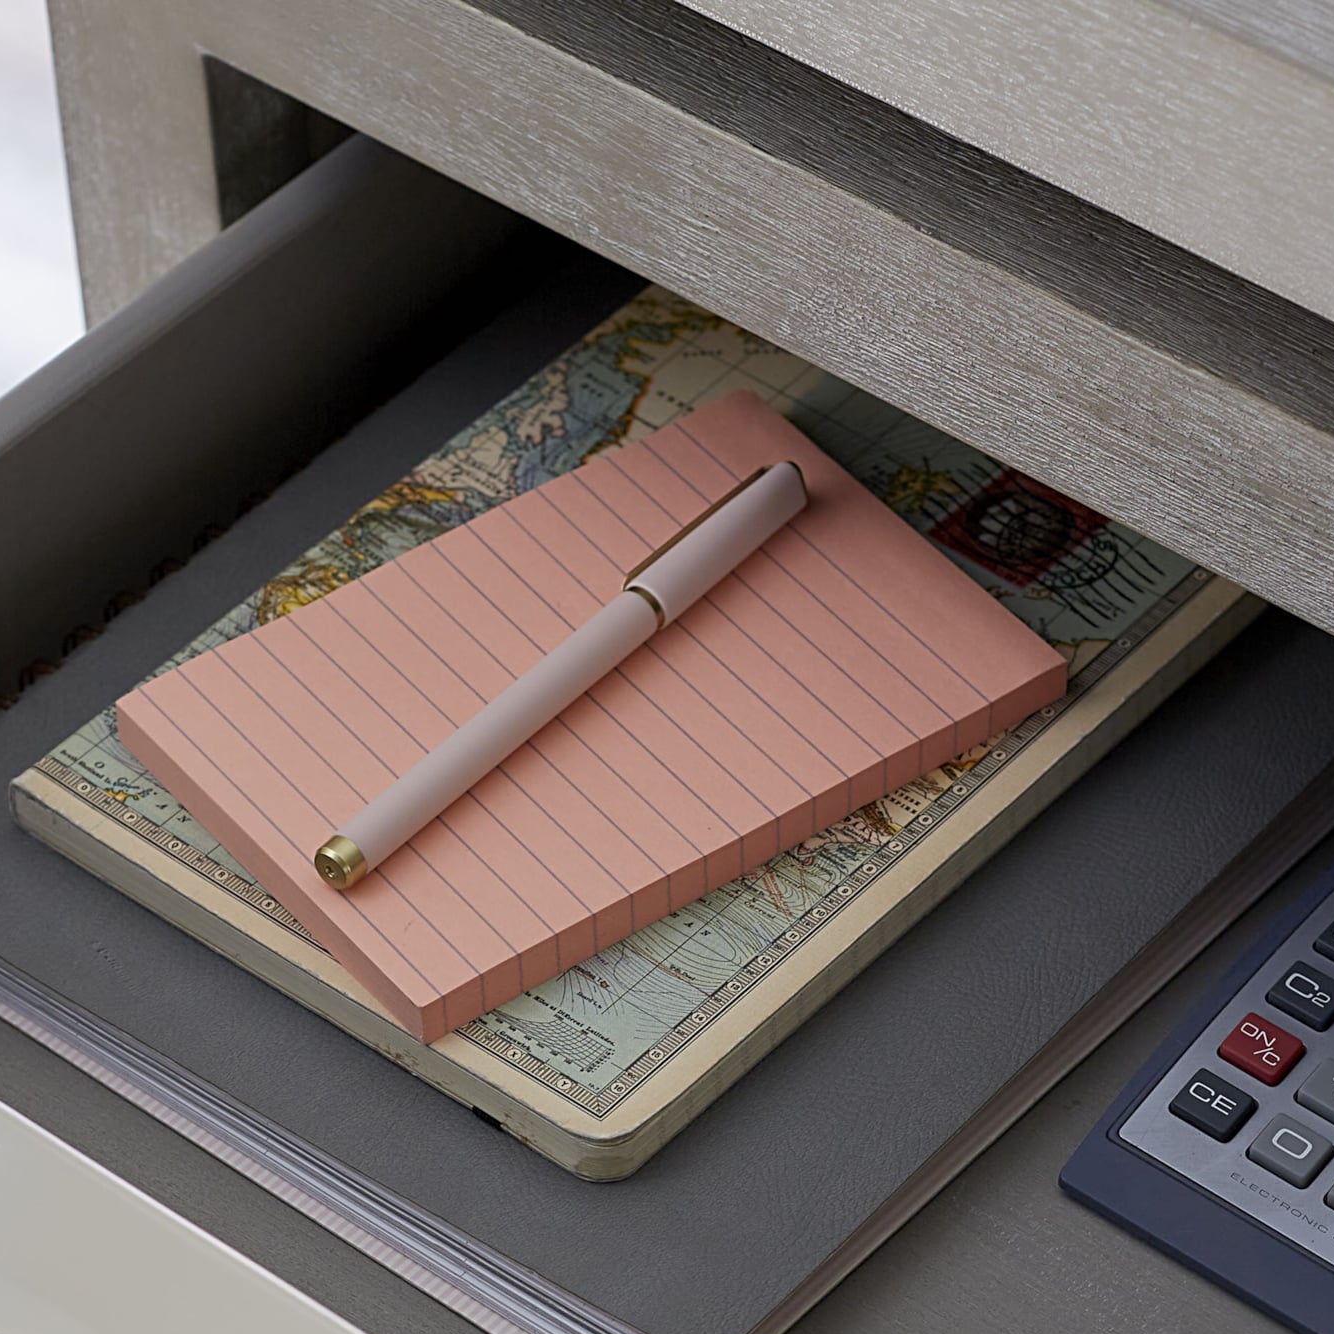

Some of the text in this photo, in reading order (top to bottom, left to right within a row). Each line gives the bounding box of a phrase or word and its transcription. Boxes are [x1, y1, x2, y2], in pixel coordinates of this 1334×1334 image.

[1284, 972, 1331, 1008] C2
[1188, 1081, 1237, 1116] CE
[1271, 1127, 1313, 1160] 0
[1229, 1171, 1329, 1234] ELECTRONIC
